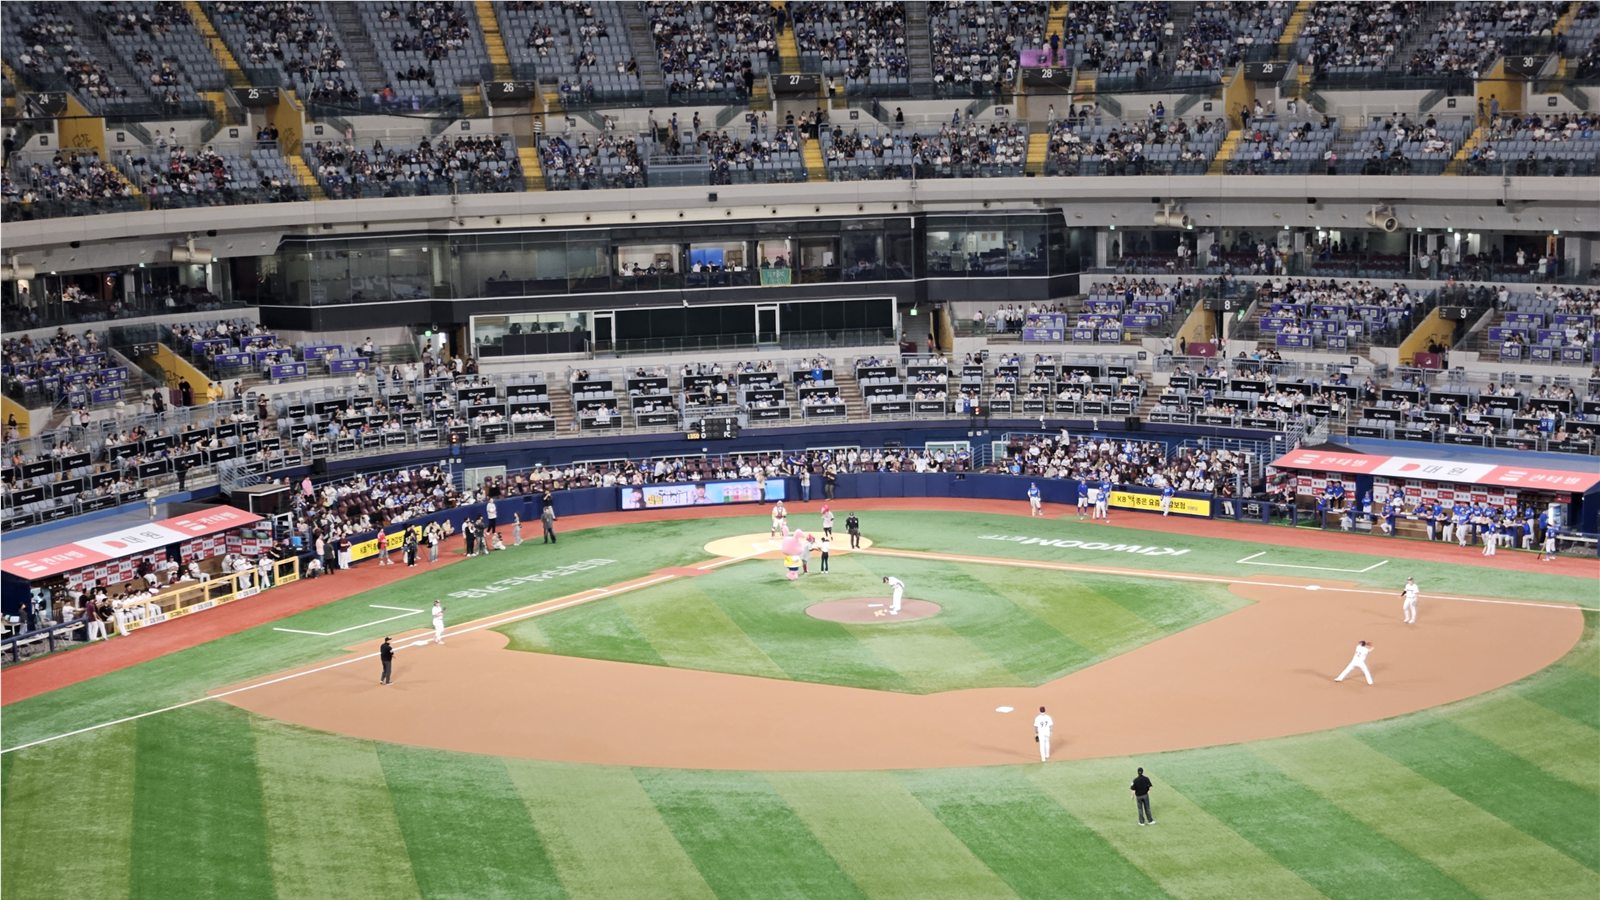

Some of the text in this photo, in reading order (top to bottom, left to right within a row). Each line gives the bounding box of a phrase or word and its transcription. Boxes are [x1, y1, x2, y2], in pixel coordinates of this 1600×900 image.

[1523, 57, 1534, 67] 30
[1262, 63, 1273, 73] 29
[1041, 69, 1053, 78] 28
[789, 75, 800, 85] 27
[503, 83, 514, 92] 26
[248, 89, 259, 99] 25
[39, 94, 49, 105] 24
[1224, 300, 1231, 310] 8
[1460, 308, 1467, 319] 9
[134, 346, 140, 356] 5
[1117, 495, 1127, 503] KB
[1021, 537, 1192, 556] KIWOOM
[1039, 721, 1048, 729] 97
